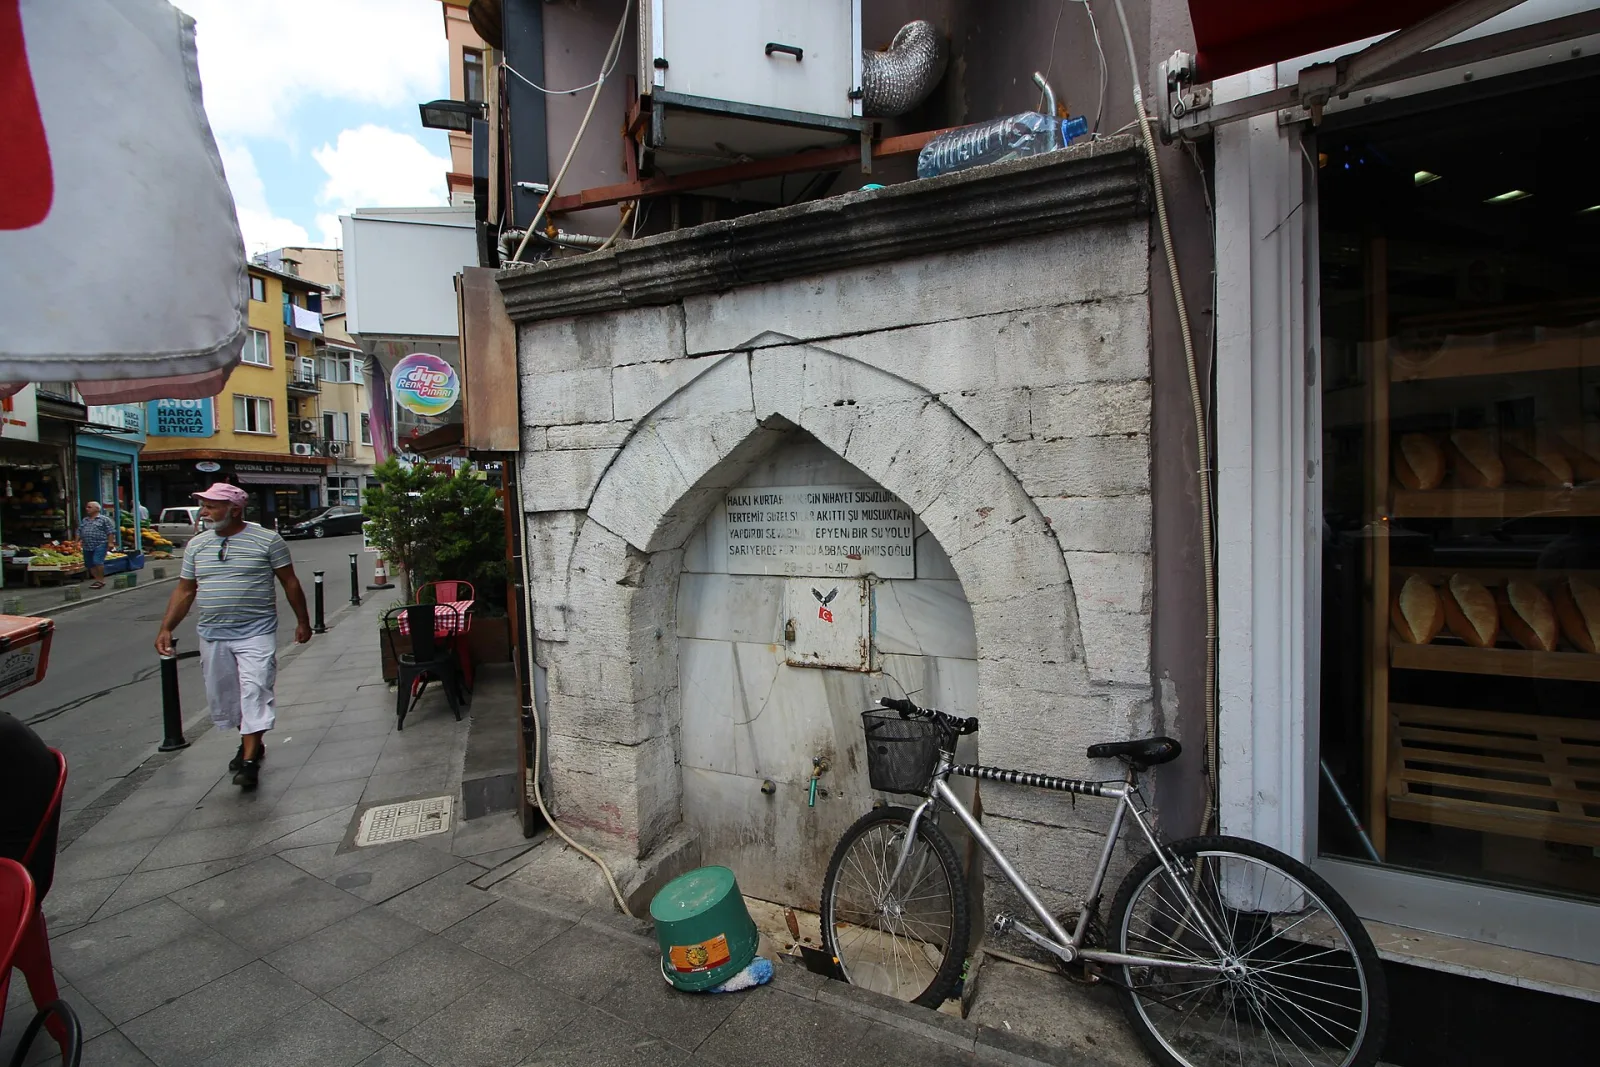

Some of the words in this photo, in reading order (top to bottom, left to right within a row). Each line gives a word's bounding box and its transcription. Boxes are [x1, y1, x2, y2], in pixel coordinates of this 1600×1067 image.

[408, 368, 445, 386] dyo
[397, 379, 423, 389] RENK
[420, 387, 451, 397] PINARI
[157, 409, 203, 417] HARCA
[158, 417, 204, 425] HARCA
[727, 495, 751, 507] HALKI
[861, 508, 911, 522] MUSLUKTAN
